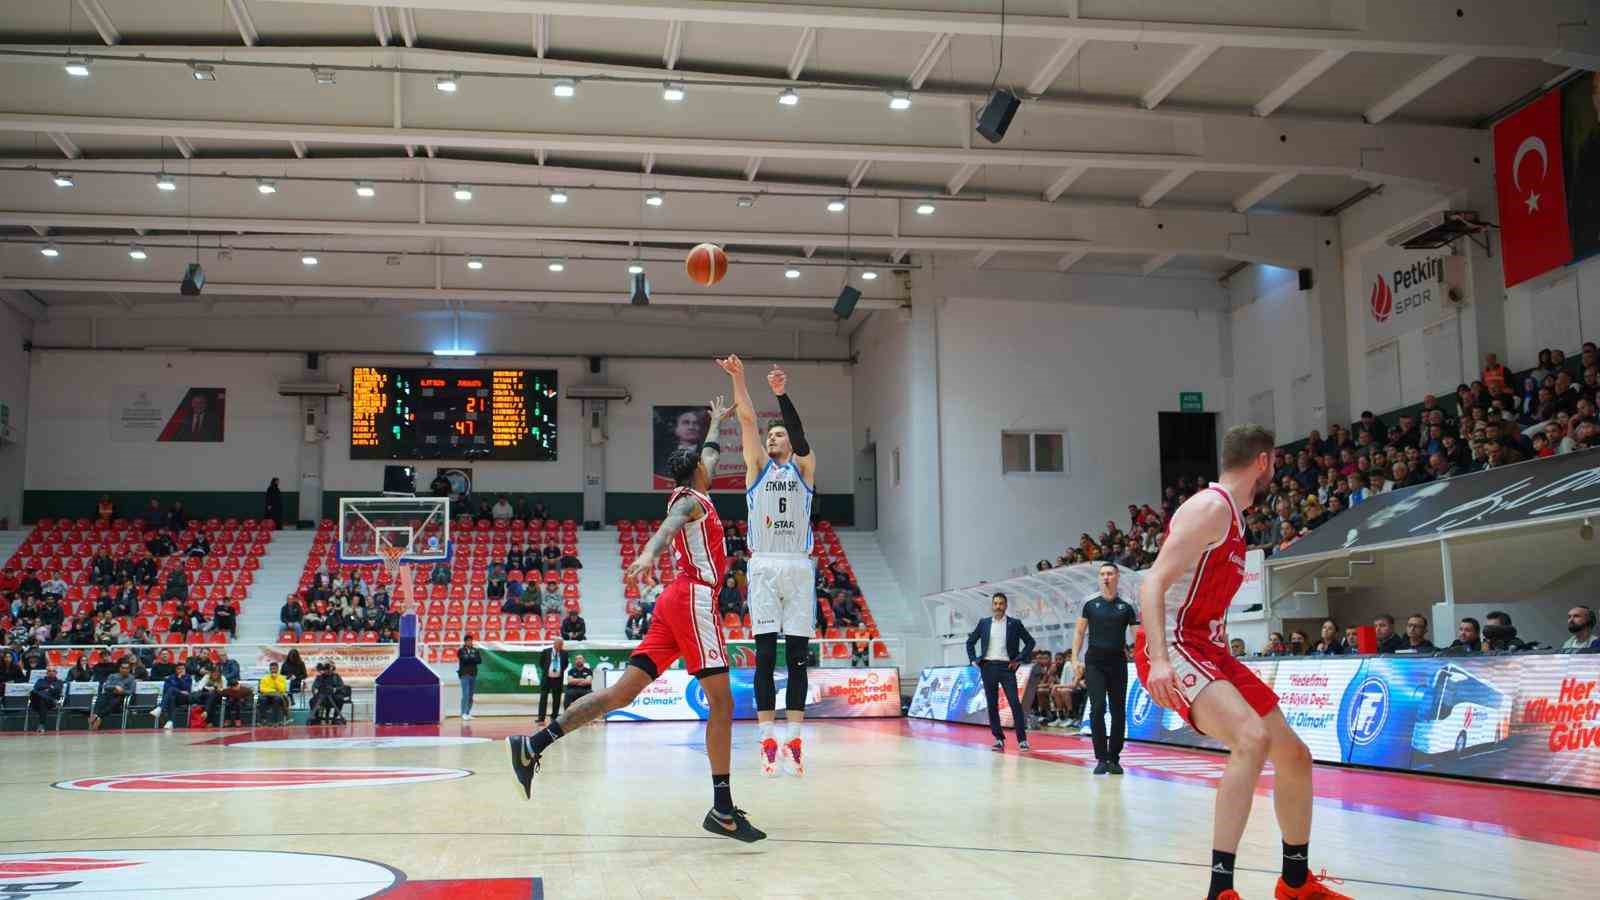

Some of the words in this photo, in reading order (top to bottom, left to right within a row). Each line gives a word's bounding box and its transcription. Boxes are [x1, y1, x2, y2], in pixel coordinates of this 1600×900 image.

[466, 397, 485, 413] 21
[455, 421, 474, 435] 47
[778, 497, 787, 514] 6
[848, 677, 865, 686] Her
[1559, 676, 1596, 703] Her
